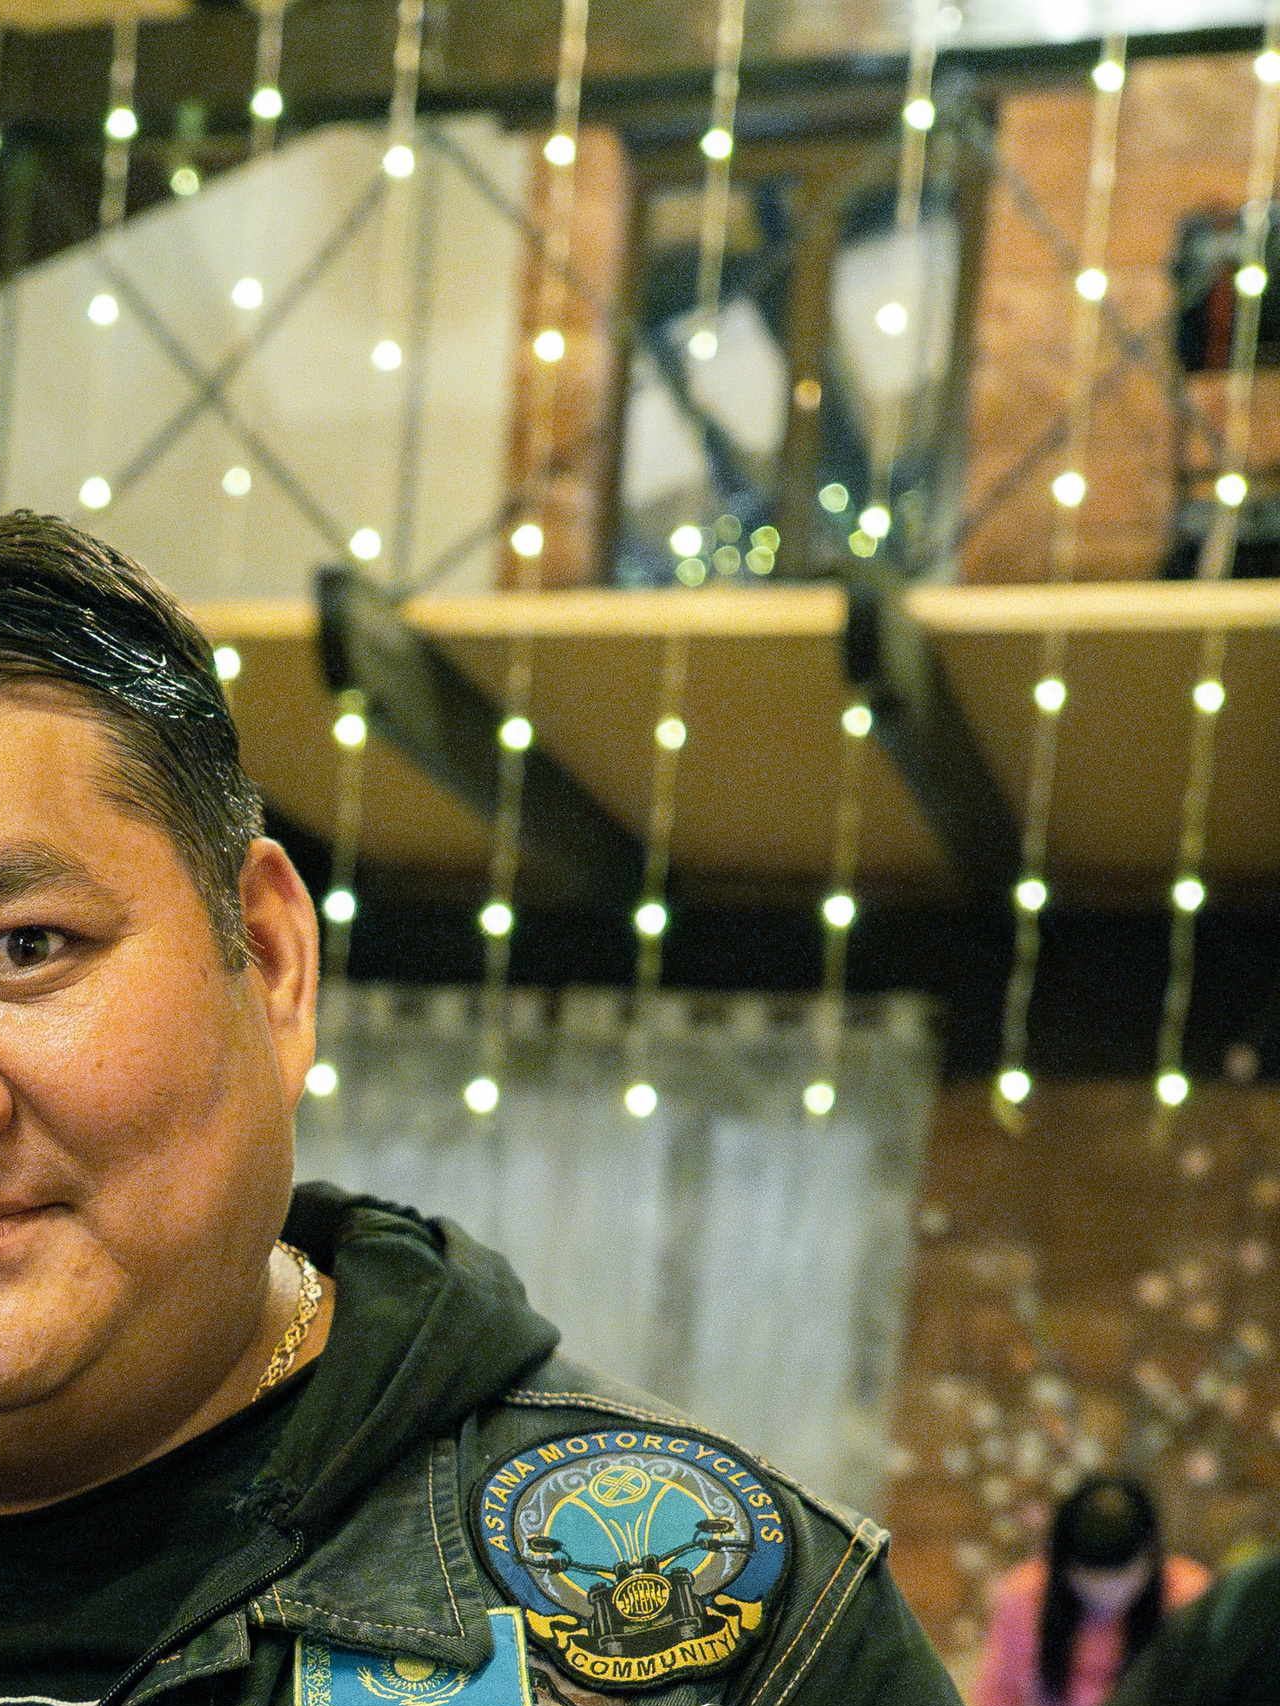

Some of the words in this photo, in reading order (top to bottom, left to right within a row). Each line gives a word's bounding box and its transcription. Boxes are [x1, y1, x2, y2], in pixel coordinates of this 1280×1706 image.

[481, 1460, 537, 1553] ASTANA
[537, 1431, 786, 1546] MOTORCYCLISTS
[570, 1638, 734, 1680] COMMUNITY
